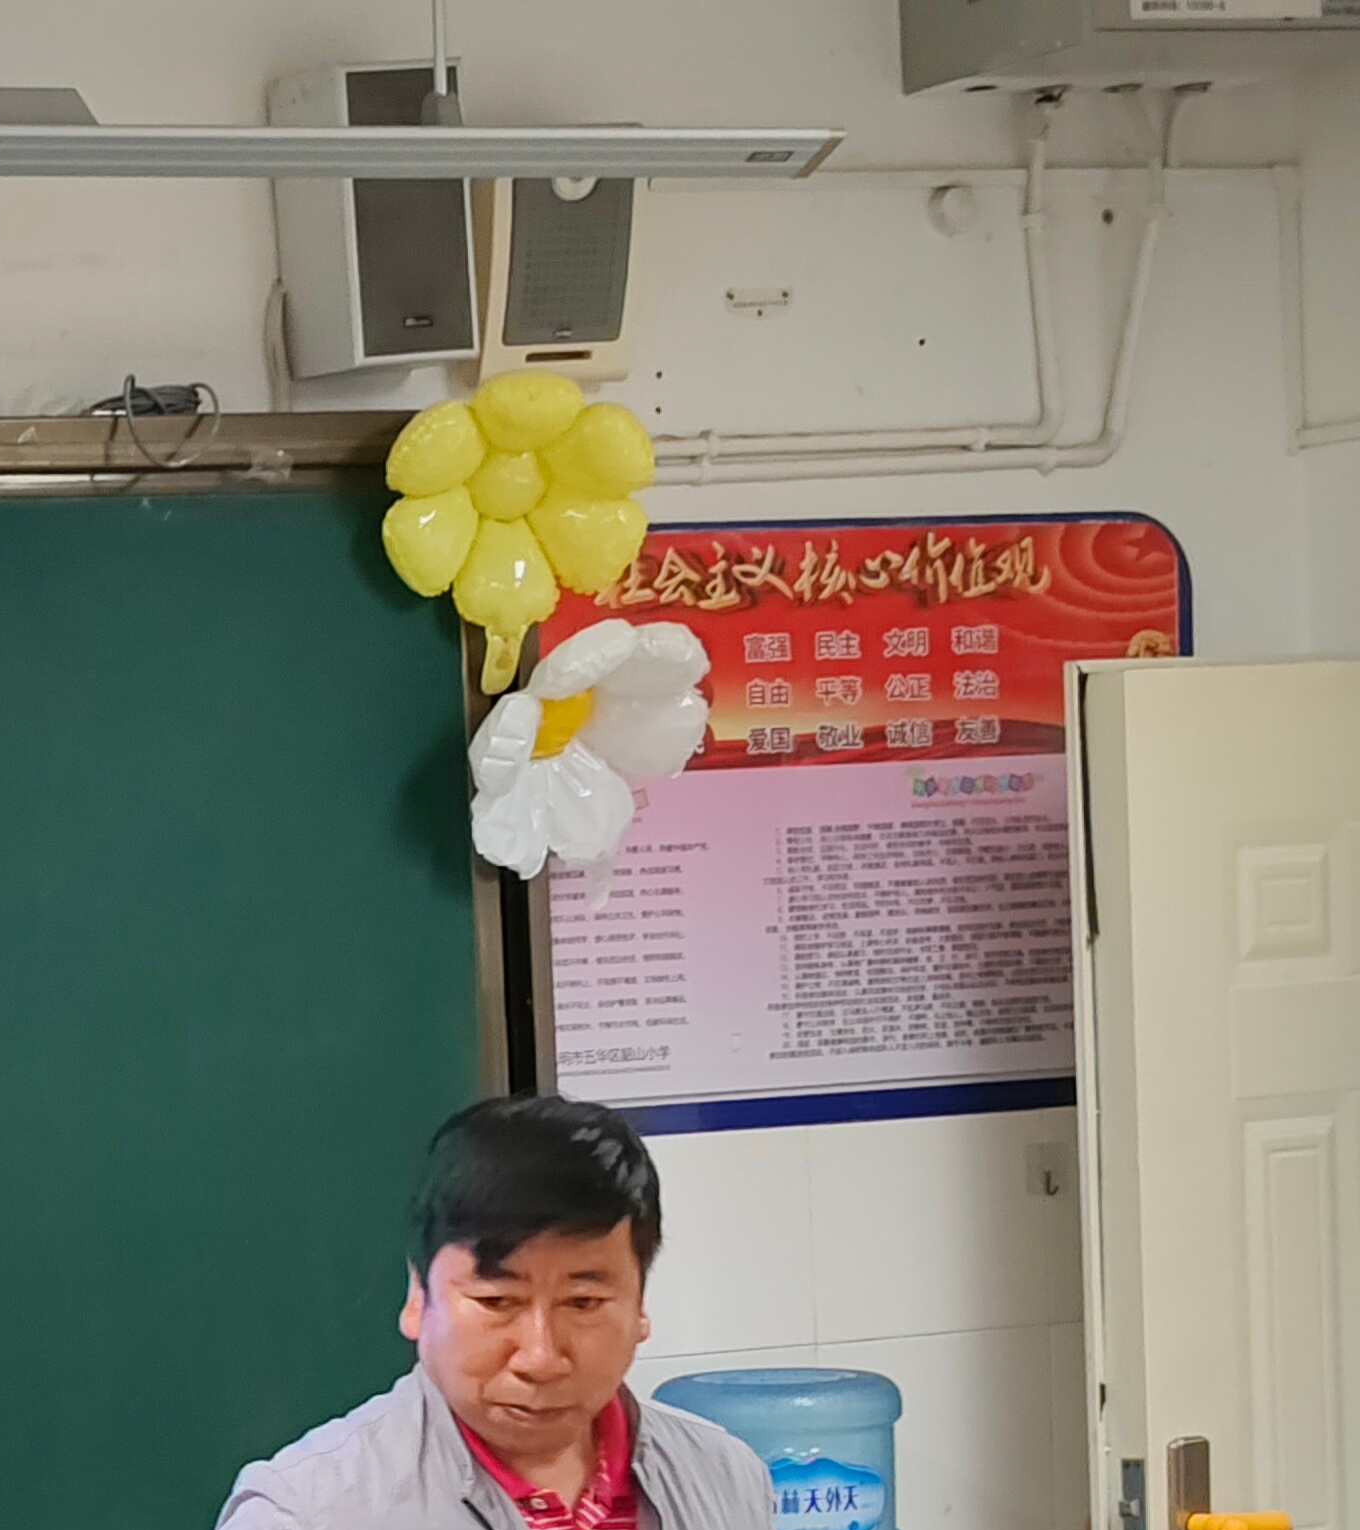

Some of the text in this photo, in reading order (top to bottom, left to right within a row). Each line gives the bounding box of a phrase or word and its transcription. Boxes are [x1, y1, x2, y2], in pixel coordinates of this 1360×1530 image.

[744, 625, 999, 662] 富强 民主 文明 和谐
[746, 671, 999, 707] 自由 平等 公正 法治
[747, 716, 1000, 754] 爱国 敬业 诚信 友善
